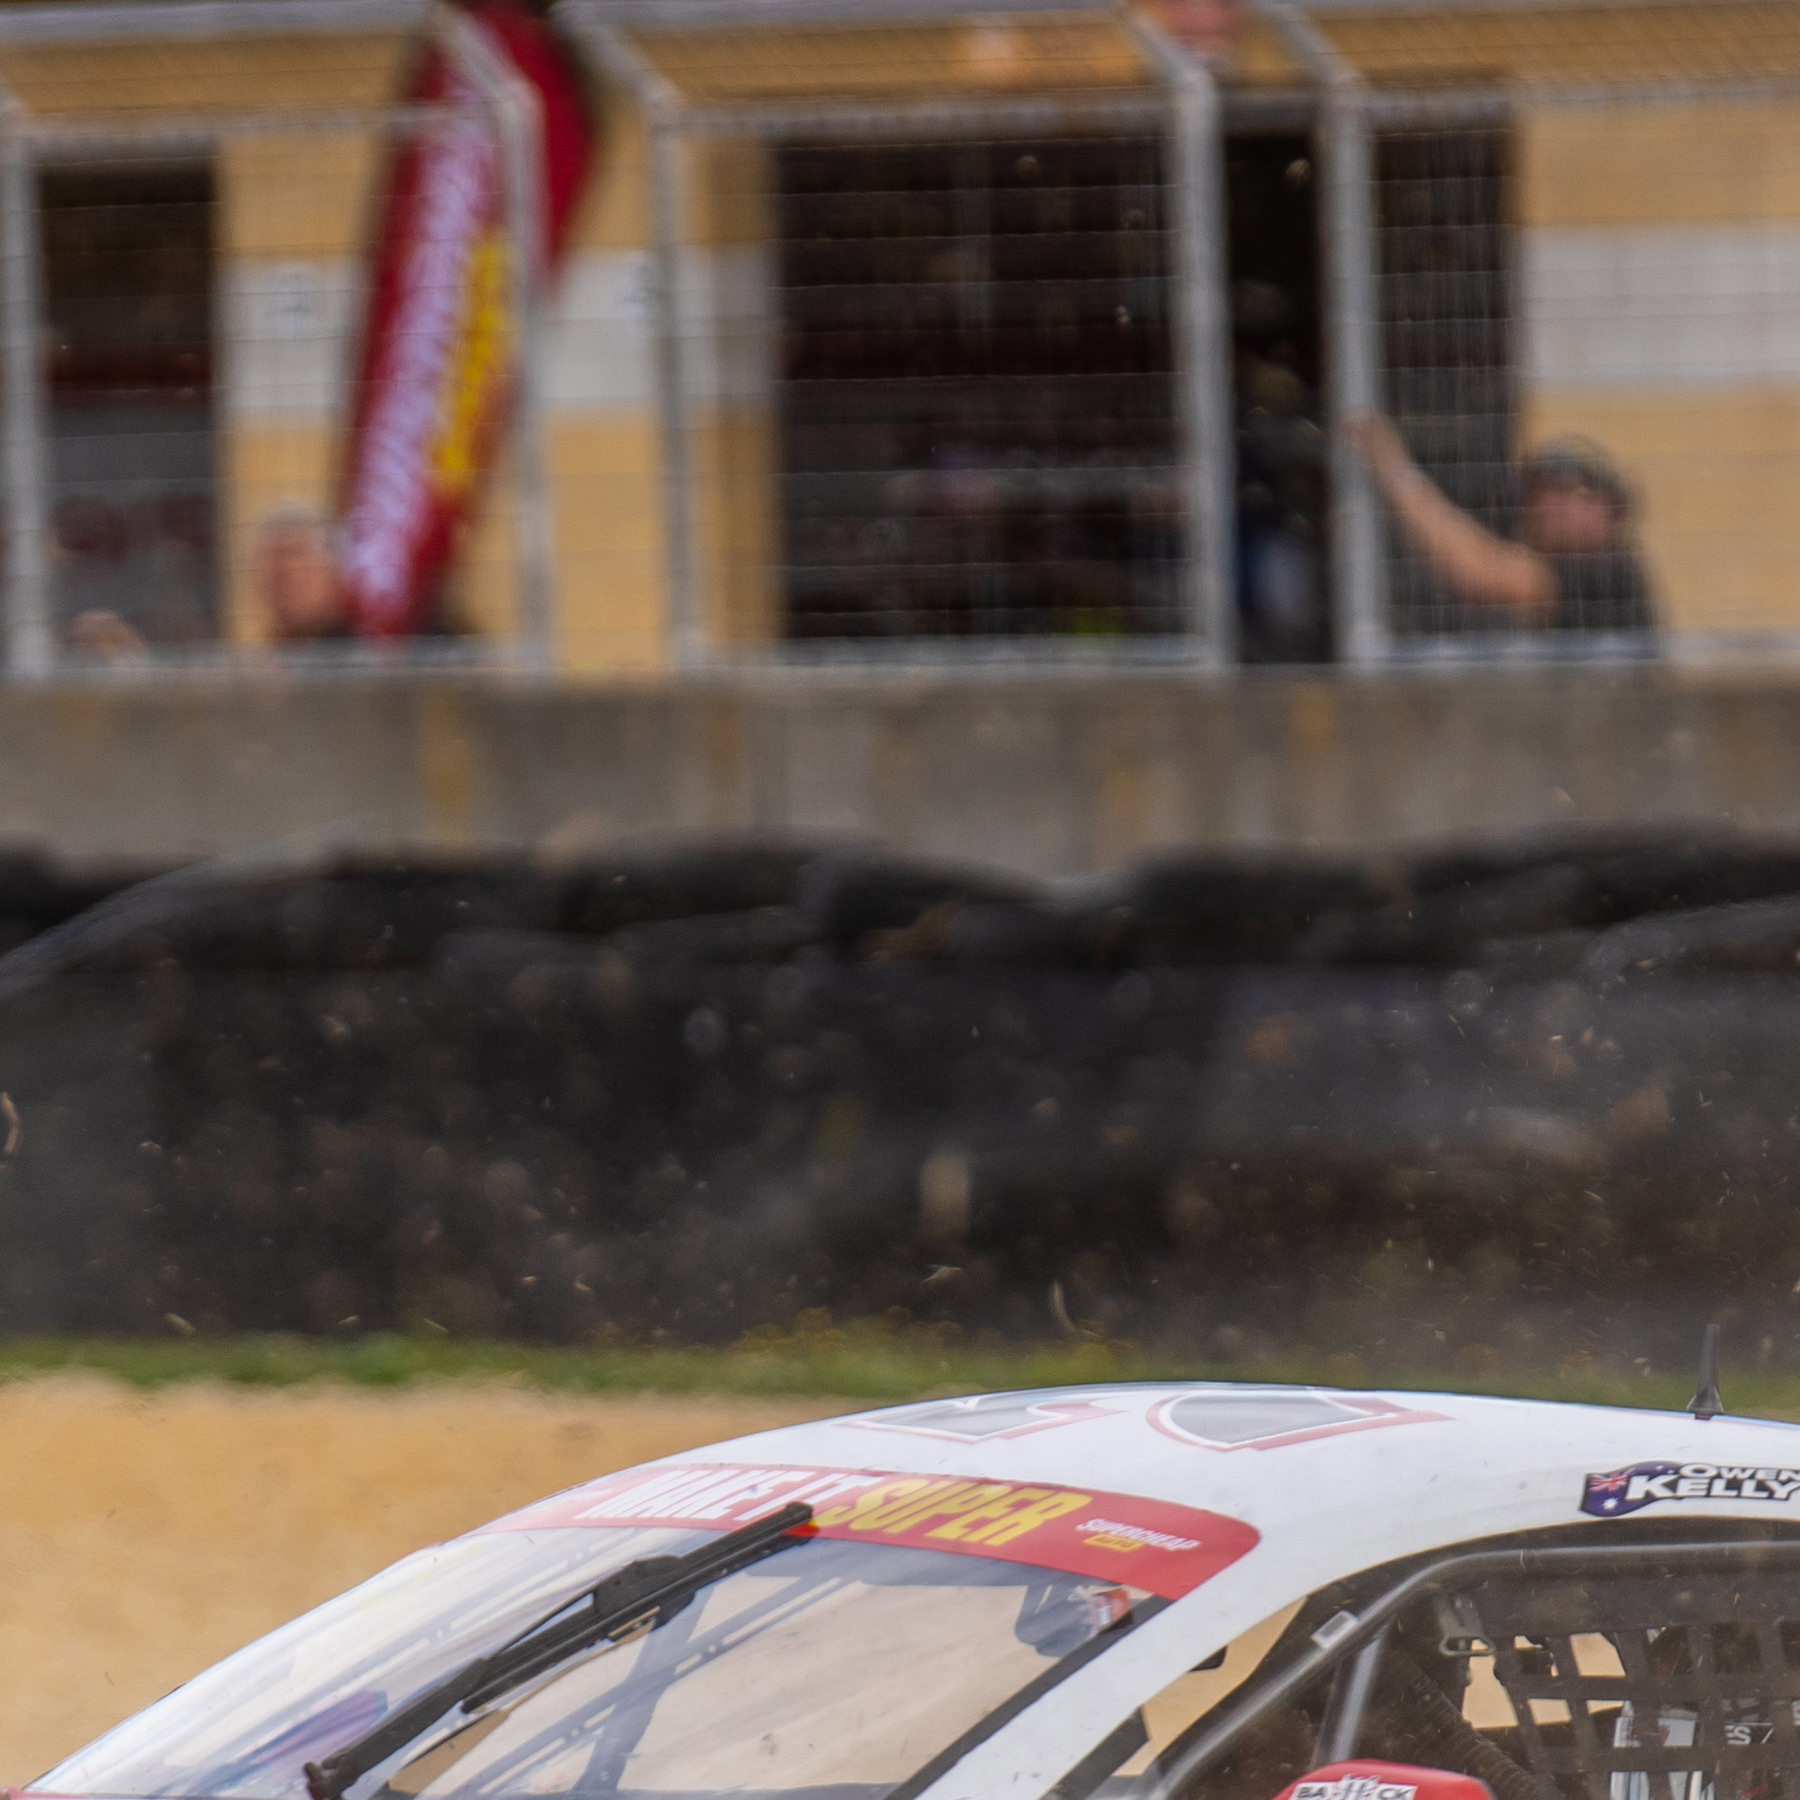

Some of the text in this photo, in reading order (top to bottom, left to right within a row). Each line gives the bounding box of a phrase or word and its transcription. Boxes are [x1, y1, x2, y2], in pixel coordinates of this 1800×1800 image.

[572, 1470, 814, 1521] MAKE
[814, 1478, 1093, 1546] SUPER
[1075, 1518, 1201, 1551] SUPERCHEAP
